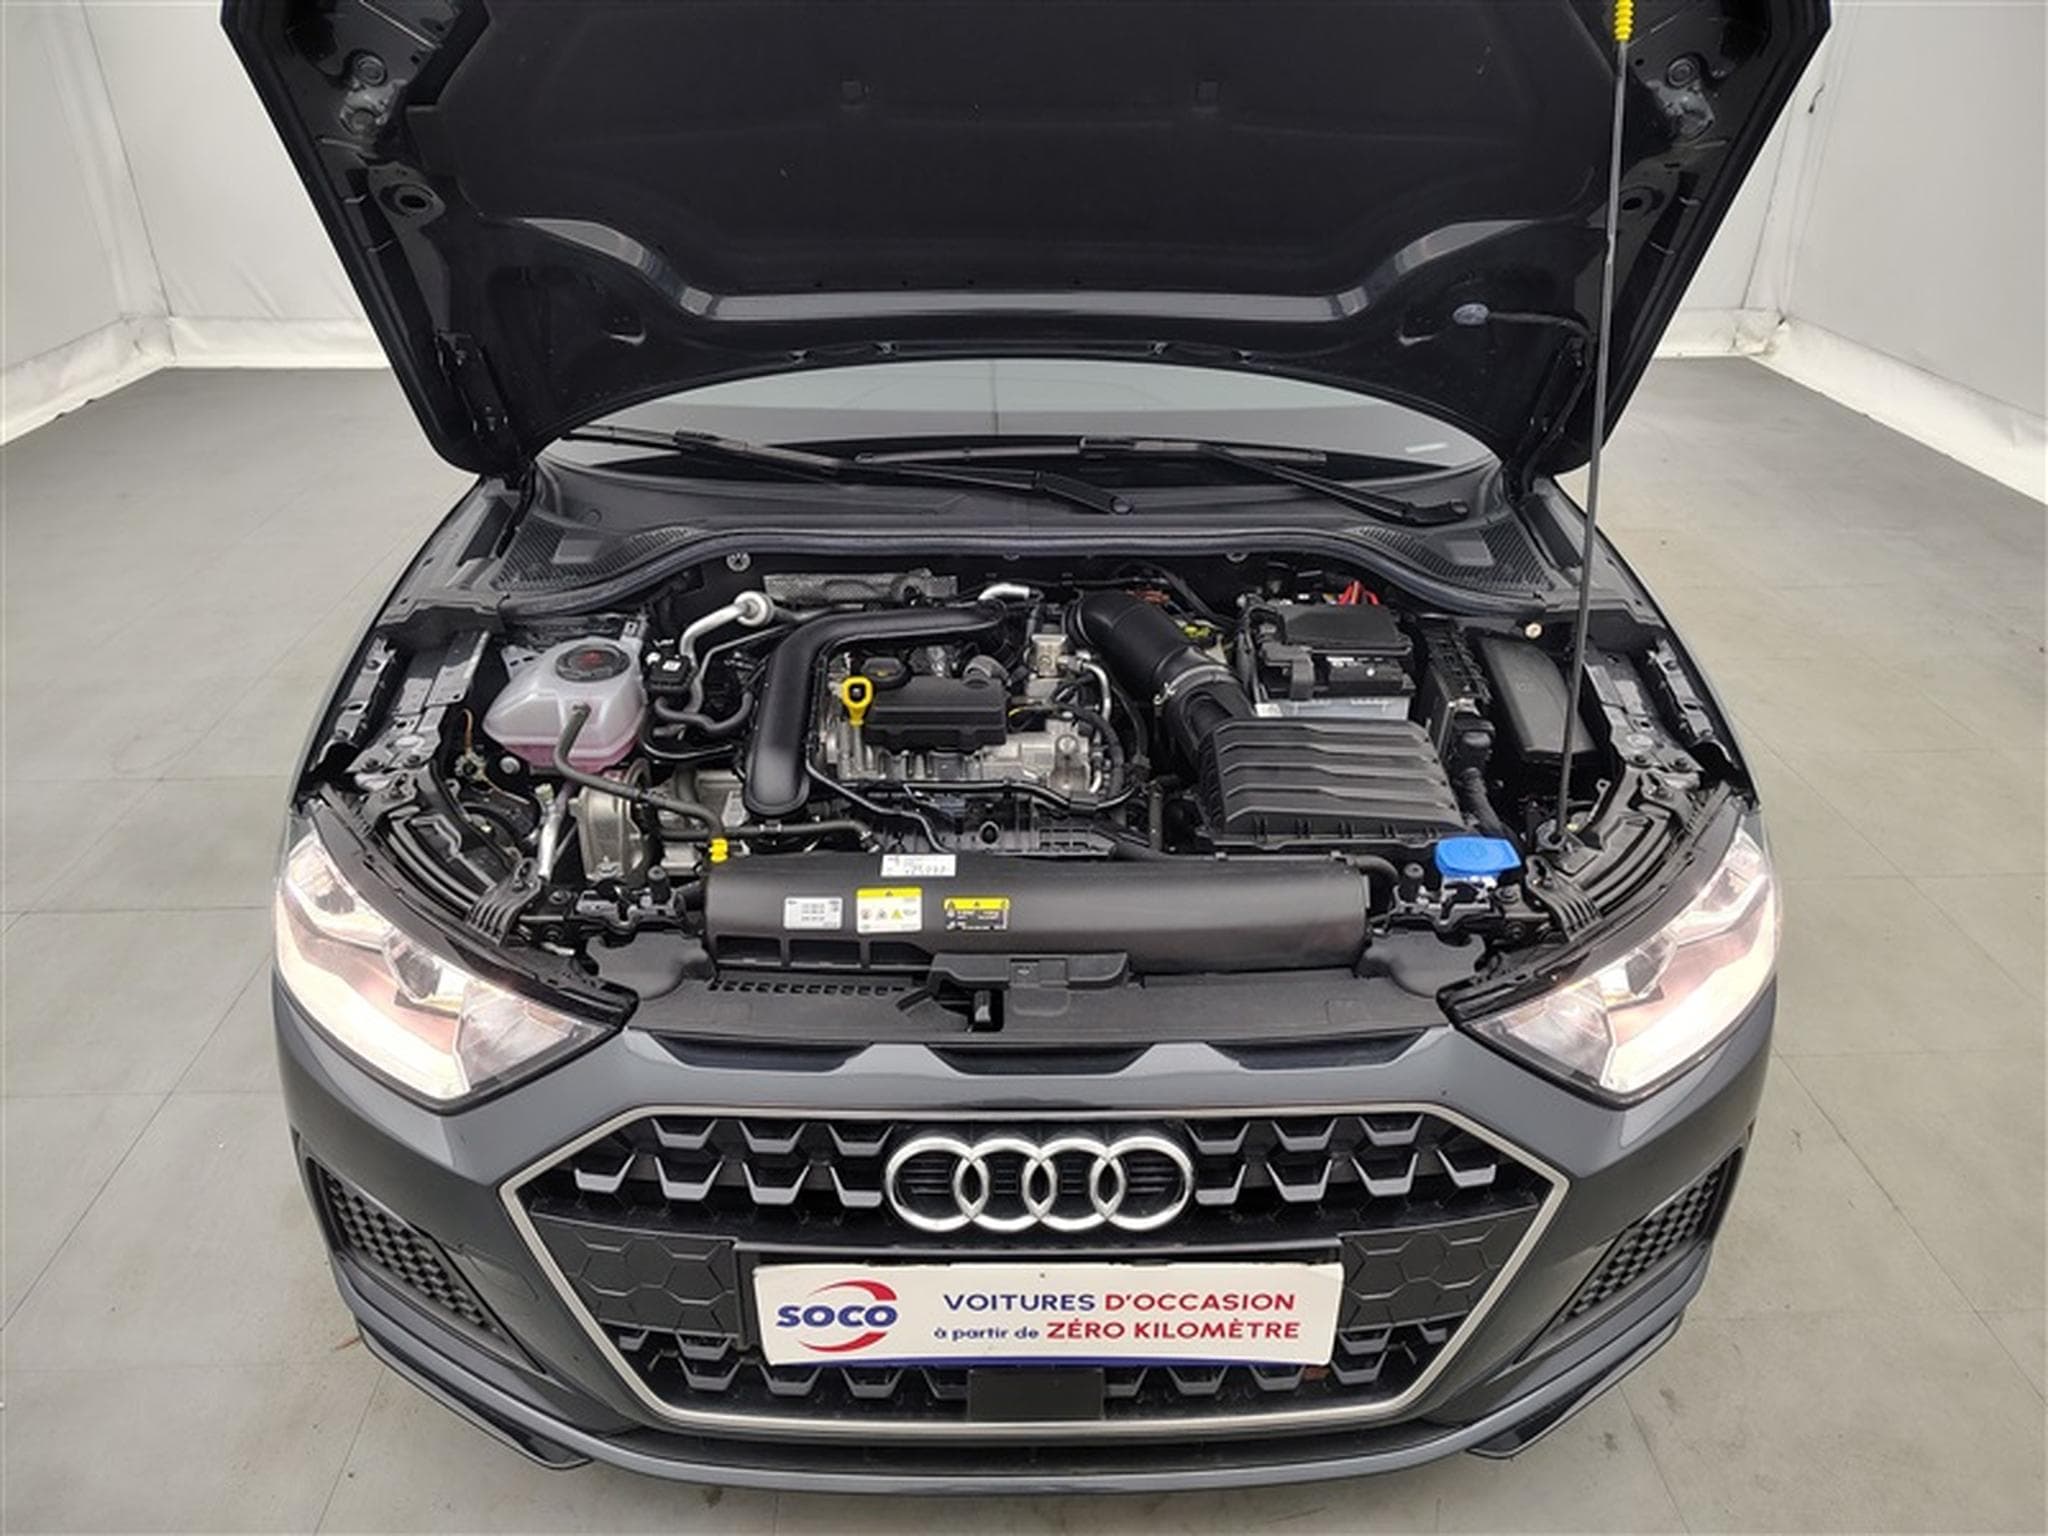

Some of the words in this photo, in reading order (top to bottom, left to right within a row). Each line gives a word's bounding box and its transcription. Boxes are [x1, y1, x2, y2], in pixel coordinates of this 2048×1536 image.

[943, 1293, 1096, 1311] VOITURES
[1104, 1293, 1295, 1311] D'OCCASION
[777, 1305, 898, 1327] SOCO
[933, 1327, 946, 1339] à
[951, 1326, 1008, 1341] partir
[1015, 1326, 1040, 1339] de
[1047, 1317, 1126, 1339] ZÉRO
[1133, 1317, 1301, 1339] KILOMÈTRE
